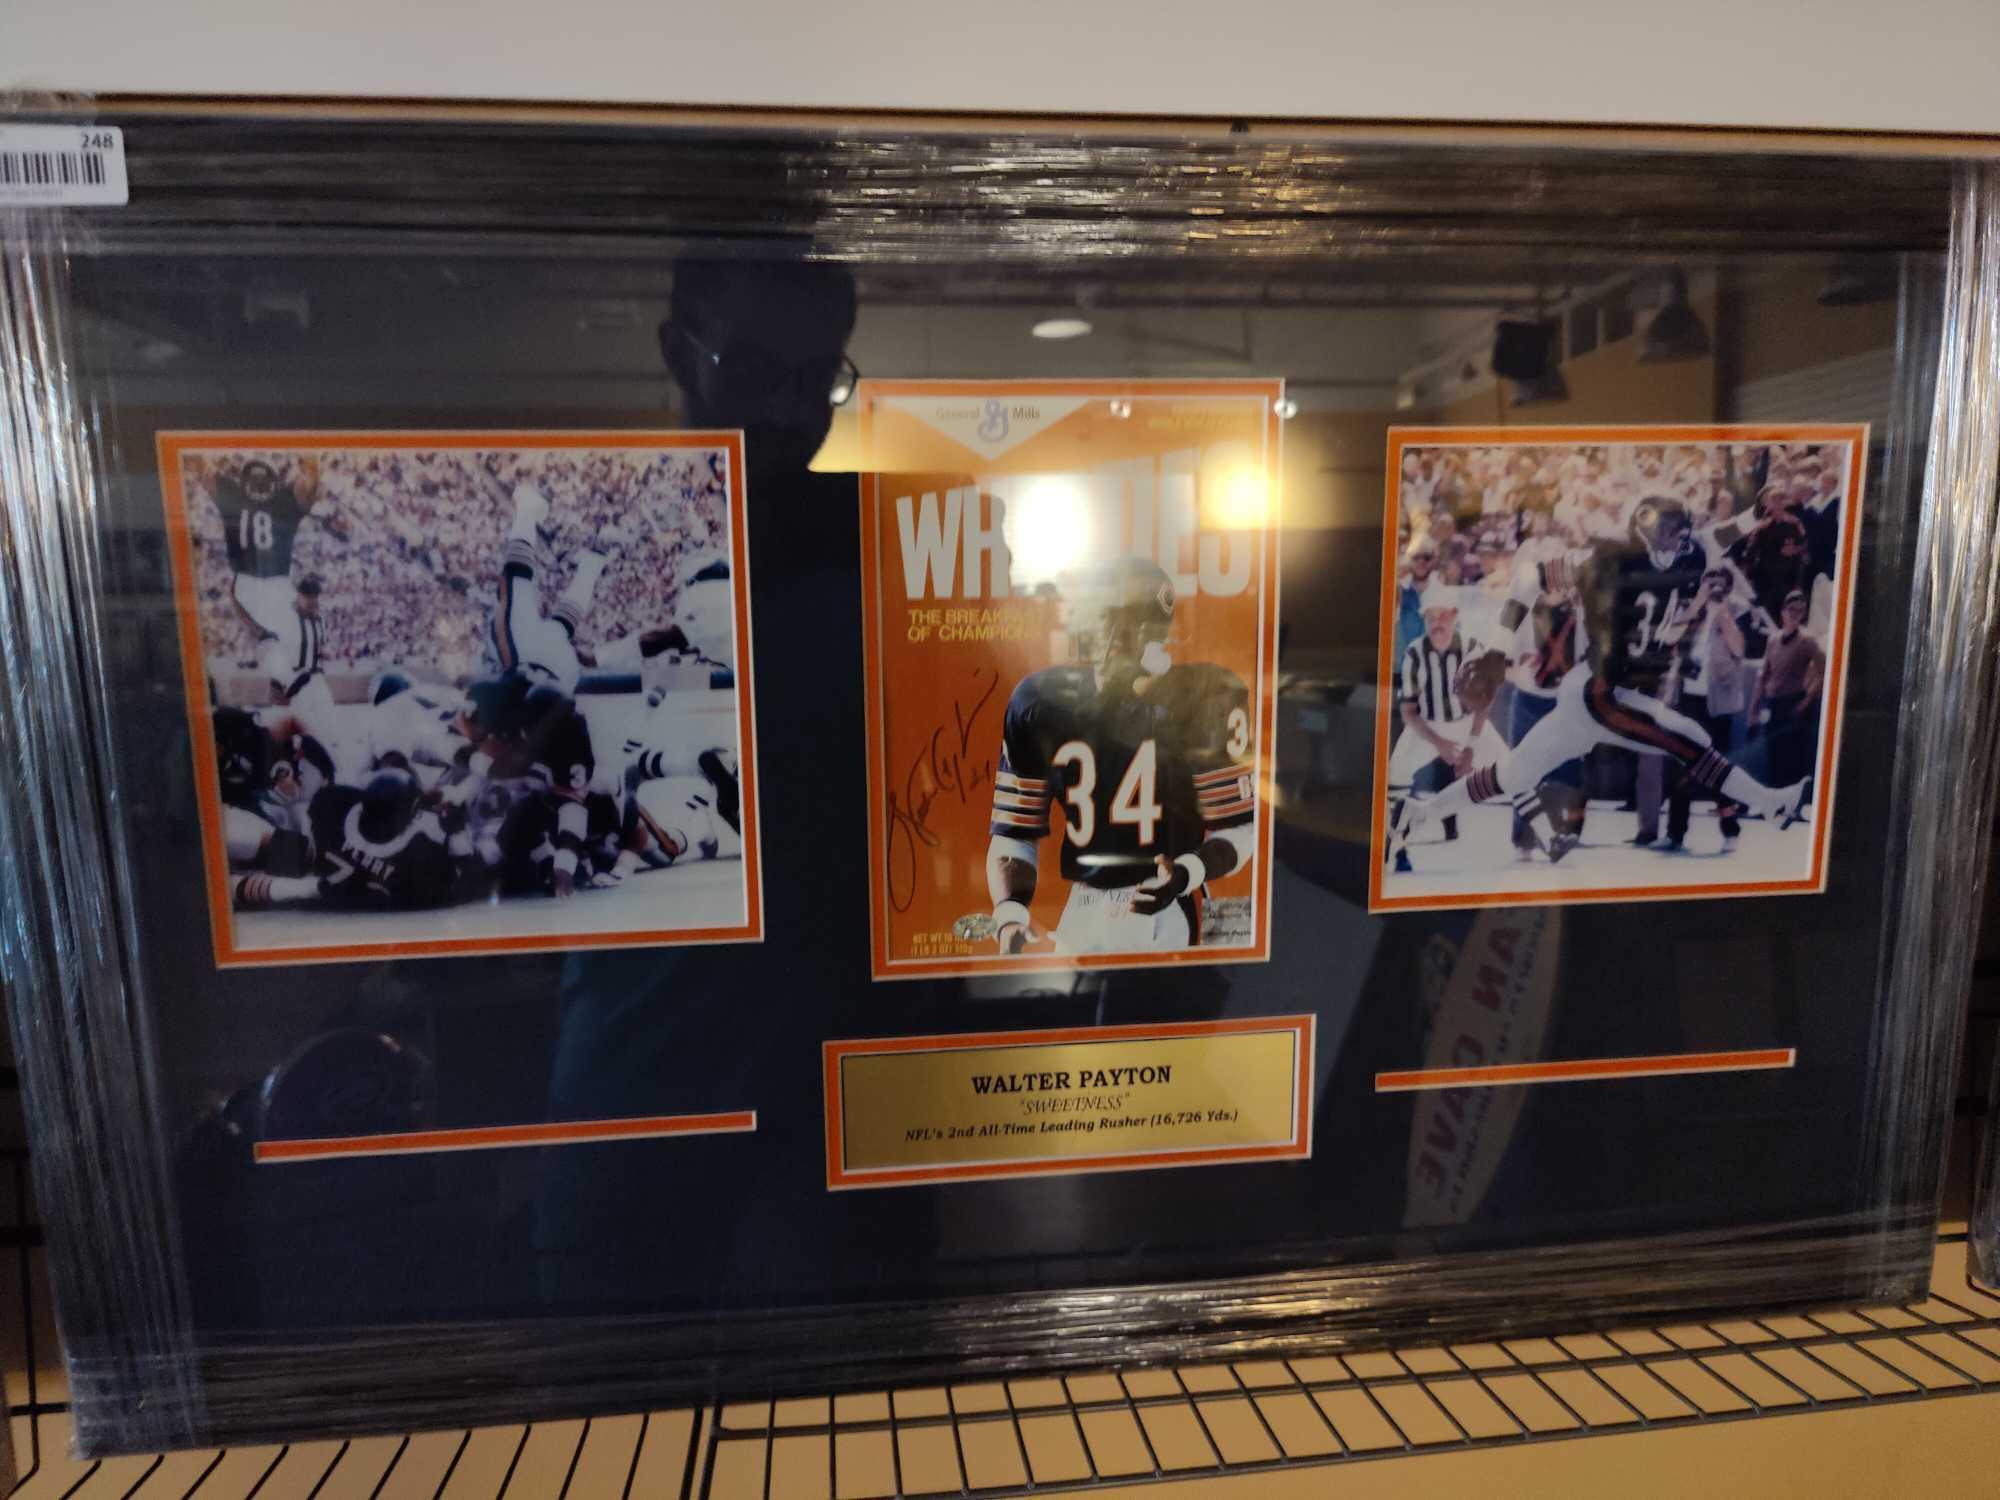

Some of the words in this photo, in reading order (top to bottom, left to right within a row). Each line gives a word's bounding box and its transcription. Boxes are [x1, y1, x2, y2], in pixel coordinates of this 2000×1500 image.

[81, 133, 114, 149] 248
[1012, 405, 1040, 420] Mills
[240, 509, 273, 550] 18
[908, 609, 941, 625] THE
[907, 624, 931, 642] OF
[1052, 739, 1162, 846] 34
[971, 1071, 1071, 1094] WALTER
[1079, 1065, 1172, 1088] PAYTON
[1020, 1092, 1131, 1115] "SWEETNESS"
[904, 1127, 944, 1142] NFL's
[948, 1125, 975, 1139] 2nd
[1040, 1119, 1095, 1133] Leading
[1099, 1115, 1148, 1129] Rusher
[1150, 1111, 1202, 1129] (16,726
